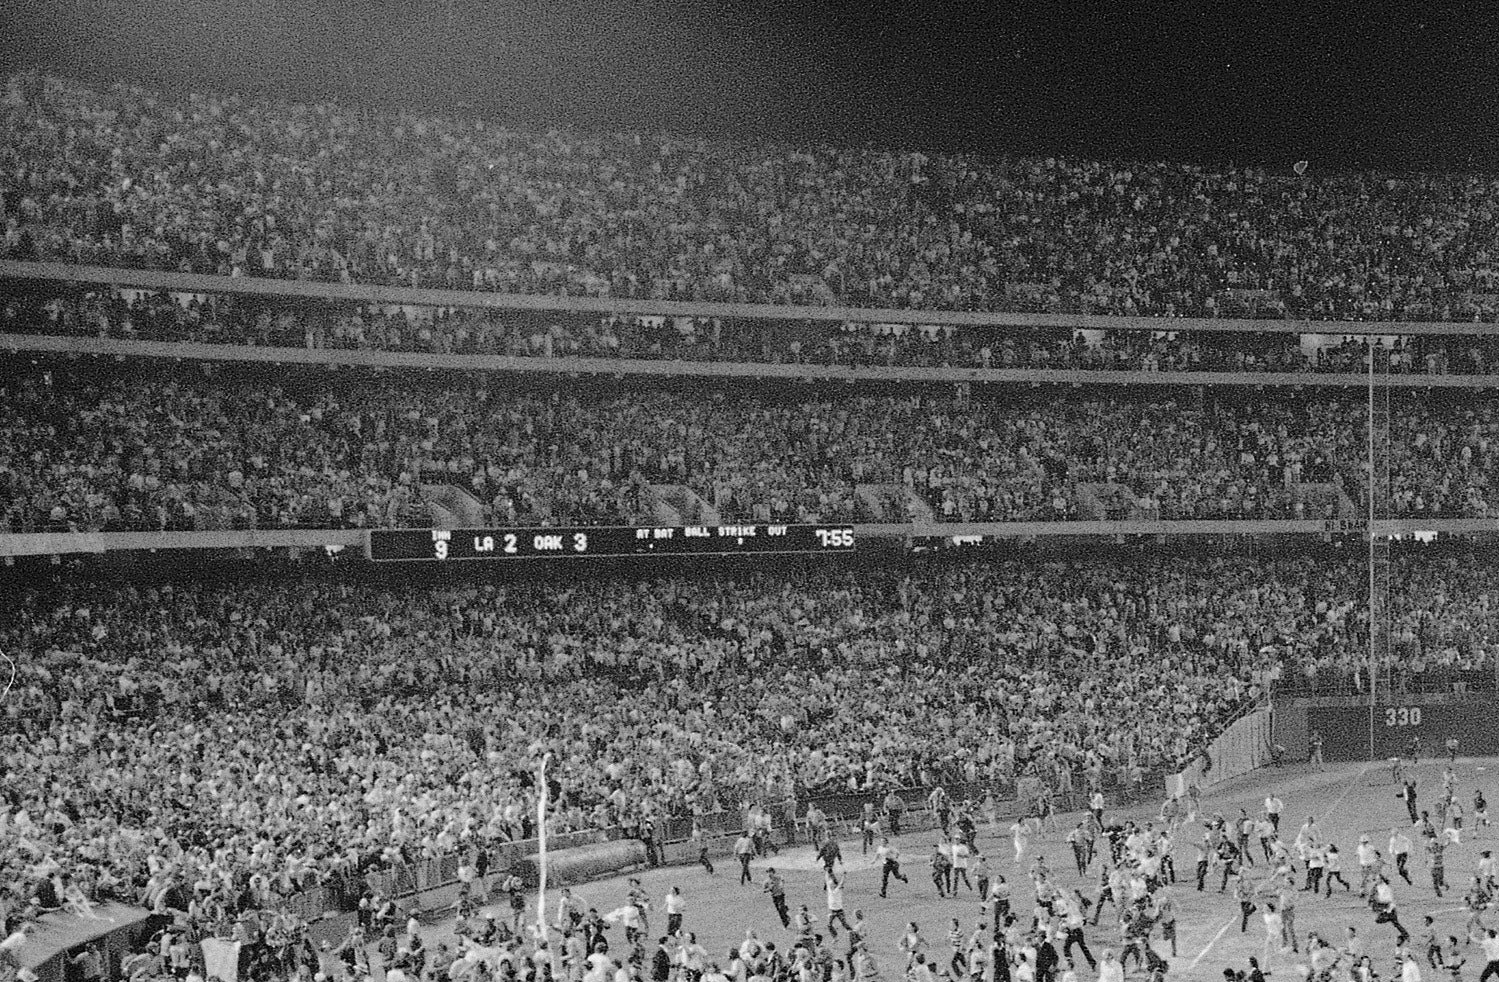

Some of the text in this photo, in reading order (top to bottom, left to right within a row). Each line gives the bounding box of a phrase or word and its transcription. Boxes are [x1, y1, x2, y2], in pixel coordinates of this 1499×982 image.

[636, 528, 674, 539] AT BAT
[684, 525, 787, 537] BALL STRIKE OUT
[434, 540, 448, 560] 9
[474, 533, 587, 553] LA 2 OAK 3
[1386, 707, 1421, 726] 330
